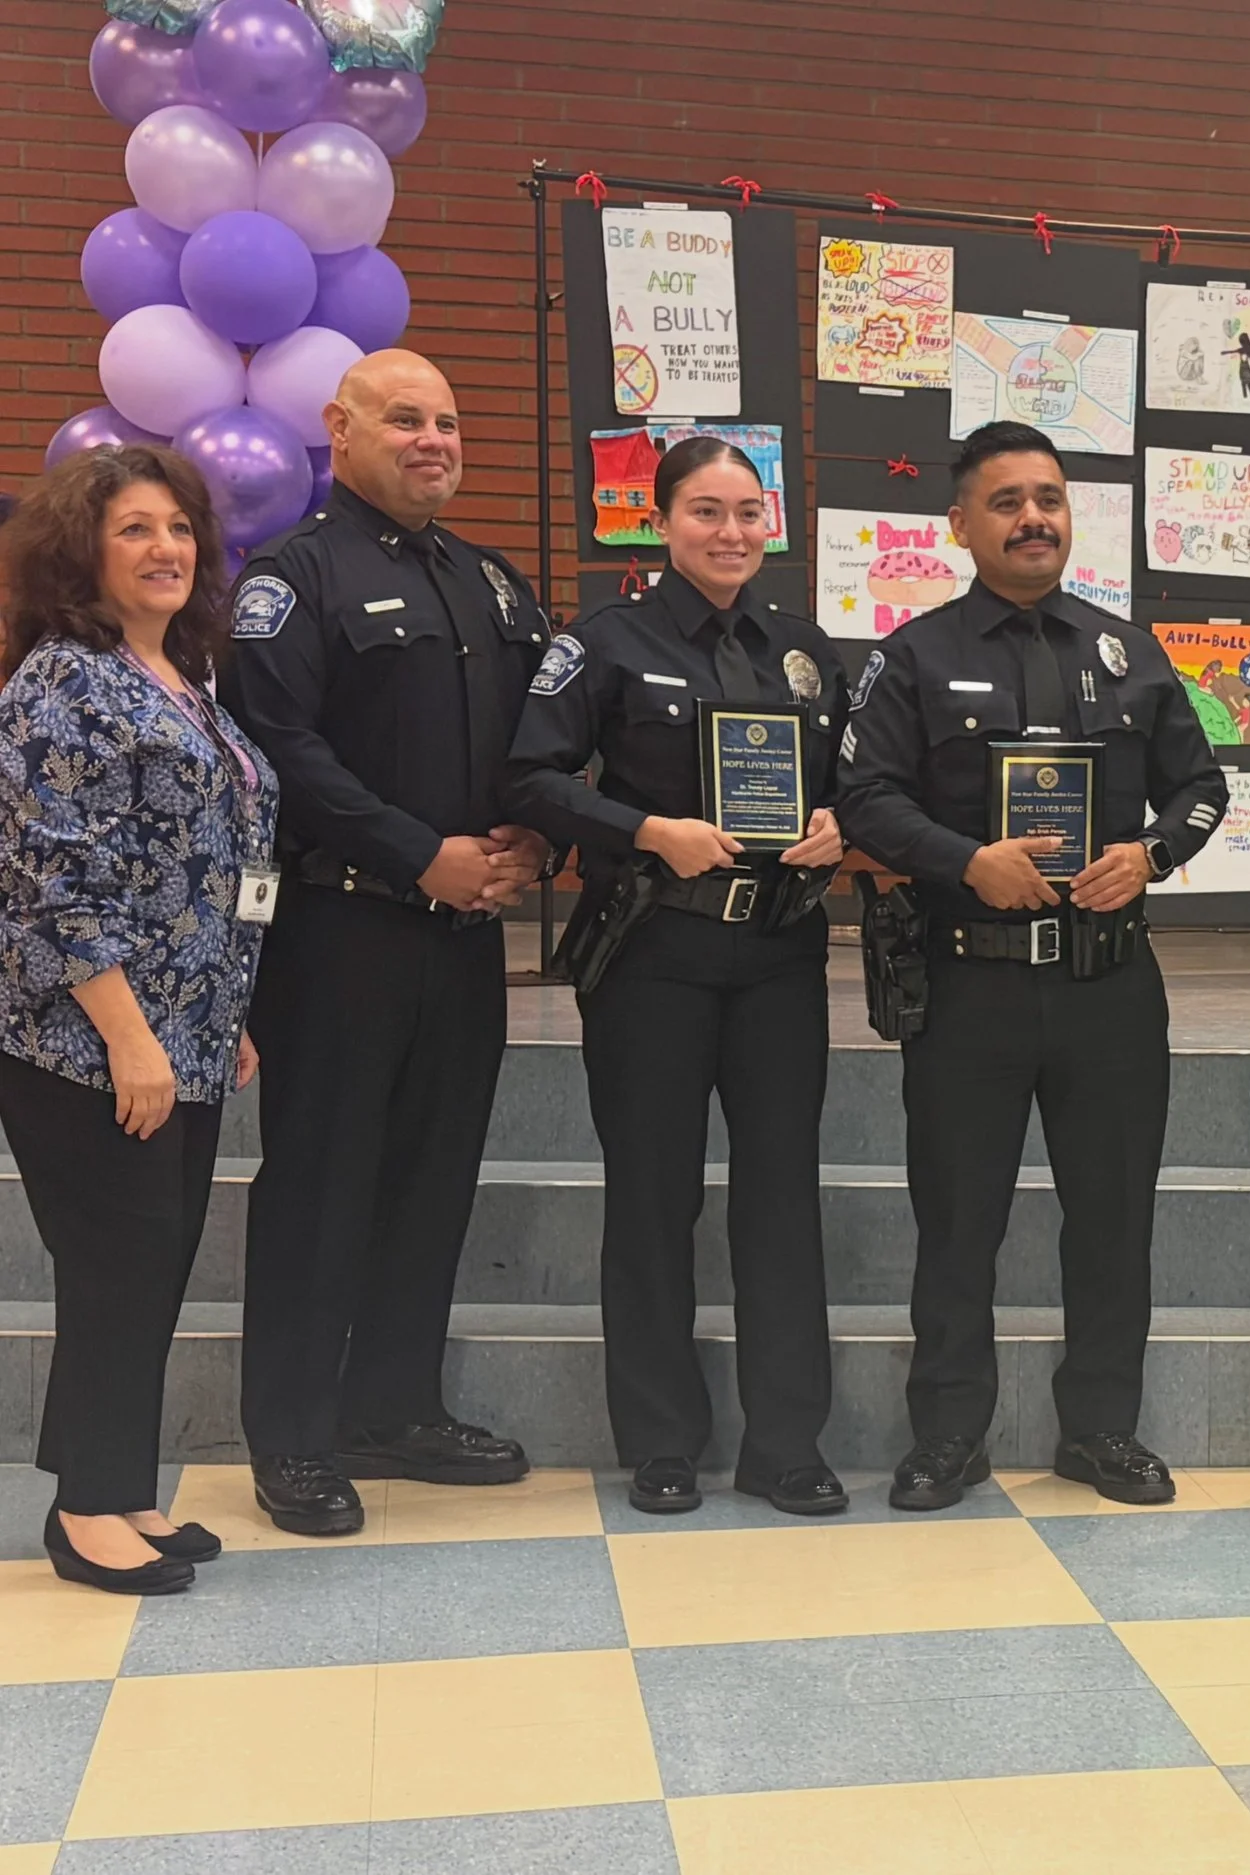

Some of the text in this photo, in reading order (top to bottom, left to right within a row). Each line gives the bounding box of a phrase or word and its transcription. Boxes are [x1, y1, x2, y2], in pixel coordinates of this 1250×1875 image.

[607, 226, 732, 258] BE A BUDDY
[647, 270, 697, 296] NOT
[615, 305, 733, 332] A BULLY
[660, 343, 738, 356] TREAT OTHERS
[668, 358, 740, 369] HOW YOU WANT
[665, 367, 739, 383] TO BE TREATED
[1169, 457, 1229, 481] STAND
[1158, 480, 1203, 494] SPEAK
[1206, 481, 1227, 494] UP
[1076, 565, 1096, 583] NO
[235, 623, 271, 633] POLICE
[722, 760, 794, 771] HOPE LIVES HERE
[1010, 804, 1085, 813] HOPE LIVES HERE
